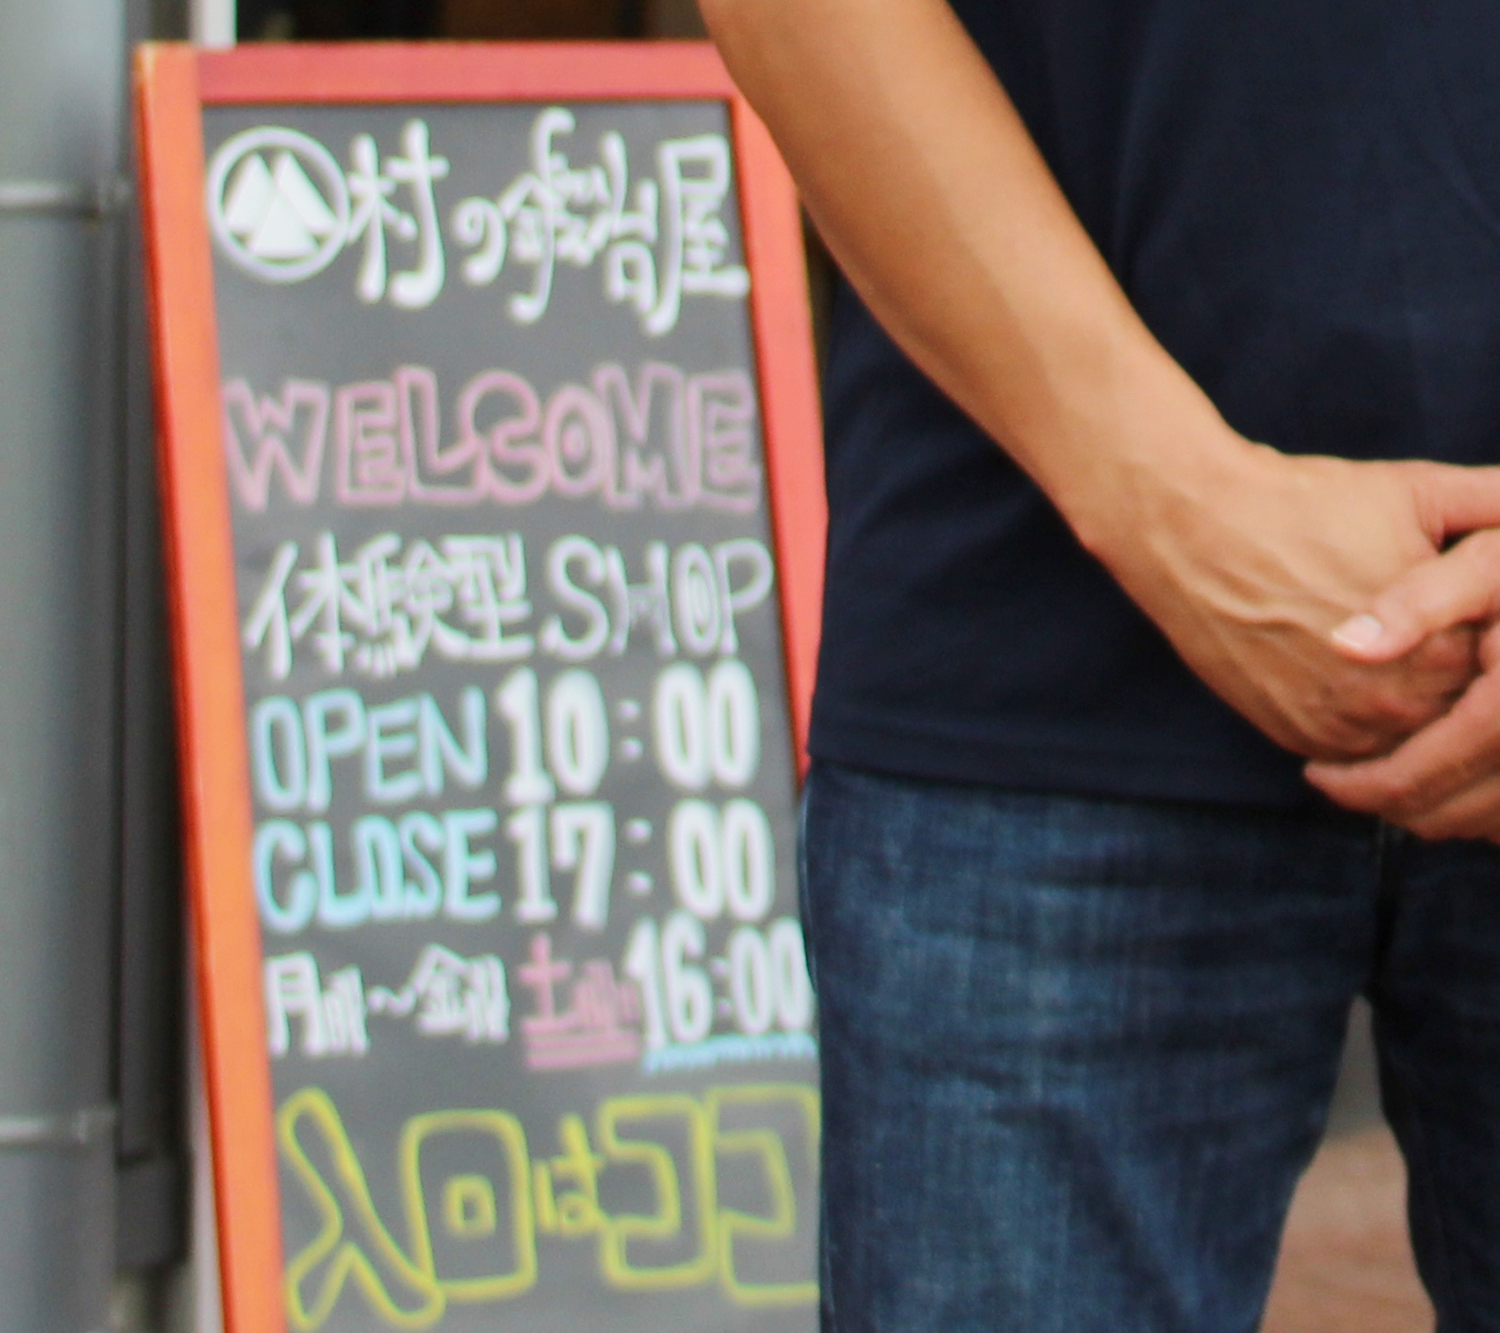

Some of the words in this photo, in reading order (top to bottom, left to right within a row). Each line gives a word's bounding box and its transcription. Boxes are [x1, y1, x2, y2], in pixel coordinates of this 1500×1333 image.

[221, 365, 762, 513] WELCOME
[244, 531, 534, 679] 体験型
[540, 534, 774, 660] SHOP
[251, 686, 488, 811] OPEN
[496, 659, 761, 804] 10:00
[253, 808, 501, 933] CLOSE
[506, 799, 776, 929] 17:00
[624, 910, 815, 1049] 16:00
